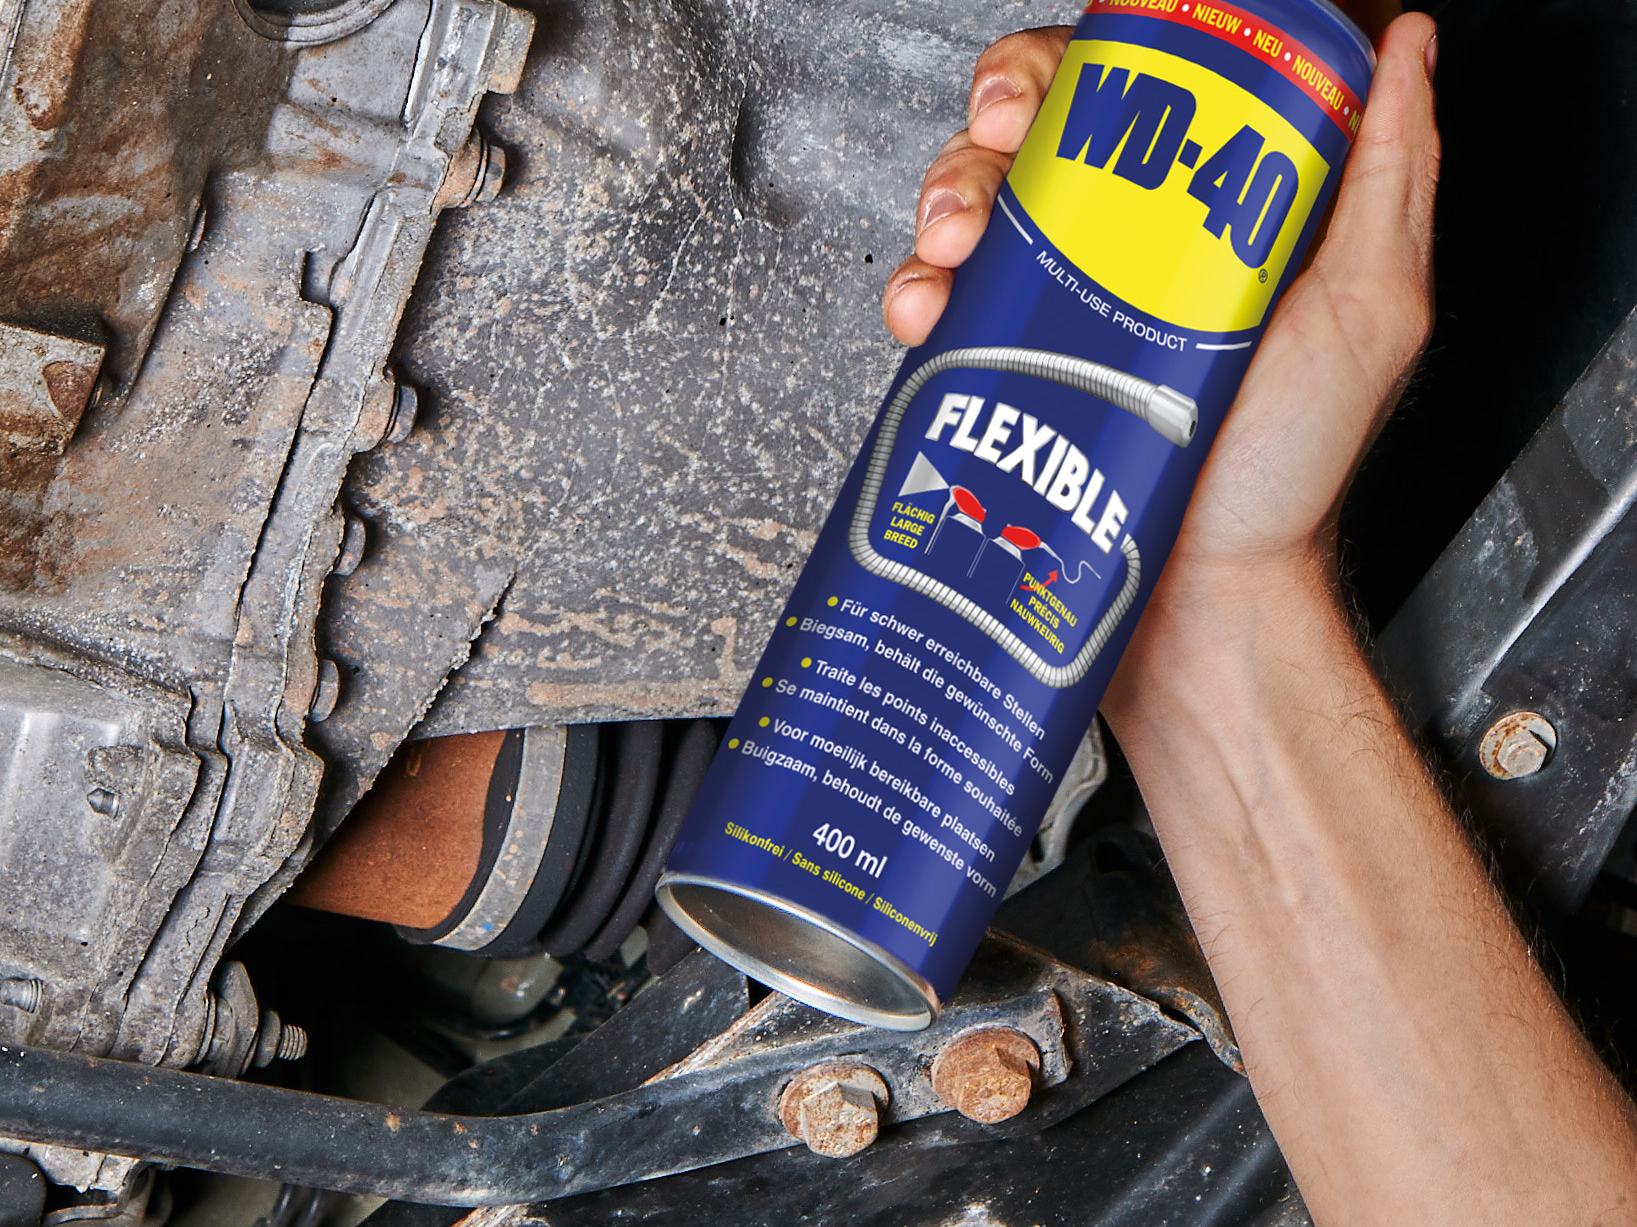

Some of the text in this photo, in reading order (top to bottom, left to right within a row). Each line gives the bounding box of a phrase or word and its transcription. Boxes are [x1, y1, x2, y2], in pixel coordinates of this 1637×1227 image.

[1192, 3, 1242, 34] NIEUW
[1253, 29, 1283, 58] NEU
[1292, 55, 1344, 111] NOUVEAU
[1056, 62, 1299, 269] WD-40
[1036, 250, 1187, 351] MULTI-USE PRODUCT
[890, 516, 925, 536] LARGE
[891, 502, 935, 524] FLÄCHIG
[925, 393, 1129, 555] FLEXIBLE
[883, 529, 918, 549] BREED
[1010, 598, 1065, 654] NAUWKEURIG
[1023, 572, 1078, 627] PUNKTGENAU
[1028, 595, 1060, 629] PRÉCIS
[799, 617, 1053, 784] Biegsam, behält die gewünschte Form
[816, 660, 1015, 795] Traite les points inaccessibles
[840, 598, 1045, 740] Für schwer erreichbare Stellen
[774, 718, 996, 862] Voor moeilijk bereikbare plaatsen
[775, 679, 1022, 837] Se maintient dans la forme souhaitée
[741, 740, 997, 898] Buigzaam, behoudt de gewenste vorm
[812, 823, 888, 878] 400 ml
[724, 821, 938, 947] Silikonfrei / Sans silicone / Siliconenvrij
